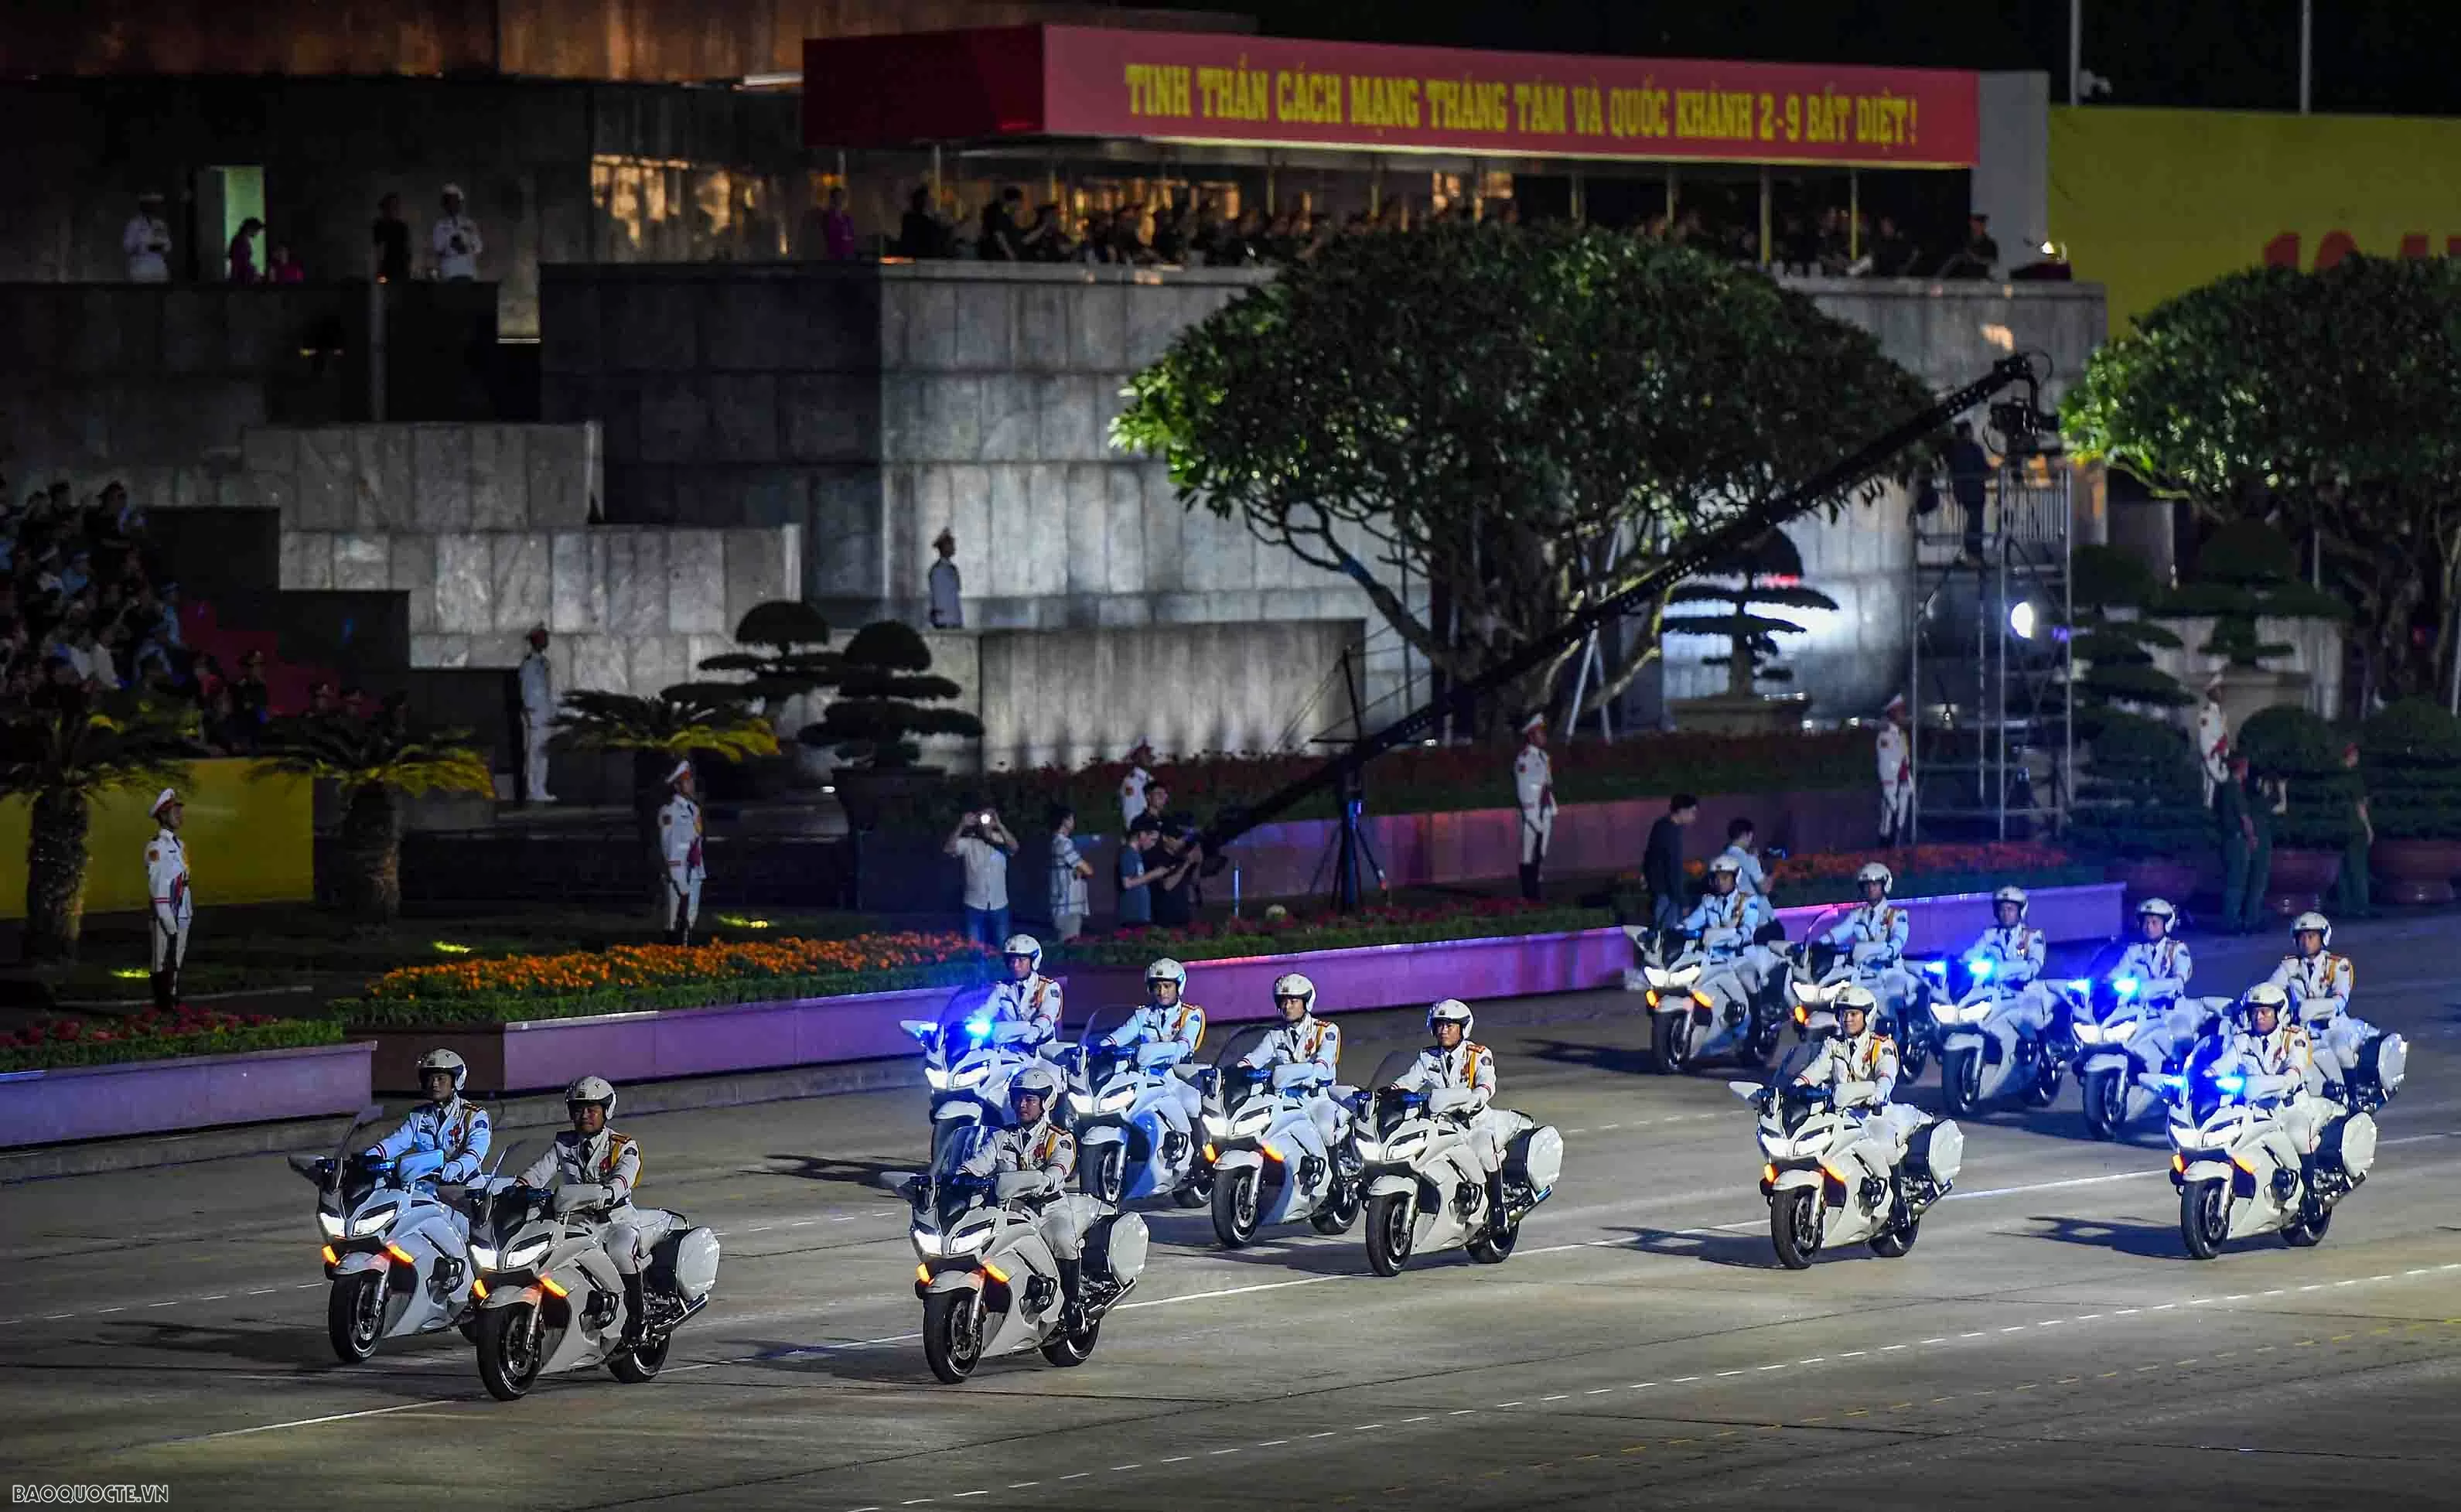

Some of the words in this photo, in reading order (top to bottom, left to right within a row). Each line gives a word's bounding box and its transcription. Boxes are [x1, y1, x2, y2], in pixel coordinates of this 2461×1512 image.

[1125, 63, 1191, 117] TINH
[1276, 61, 1343, 124] CÁCH
[1349, 74, 1421, 136] MẠNG
[1425, 71, 1507, 131] THÁNG
[1514, 75, 1566, 134] TÁM
[1572, 74, 1604, 135] VÀ
[1609, 74, 1669, 138] QUỐC
[1674, 81, 1753, 140] KHÁNH
[1807, 81, 1850, 142] BẤT
[1856, 87, 1918, 153] DIỆT!
